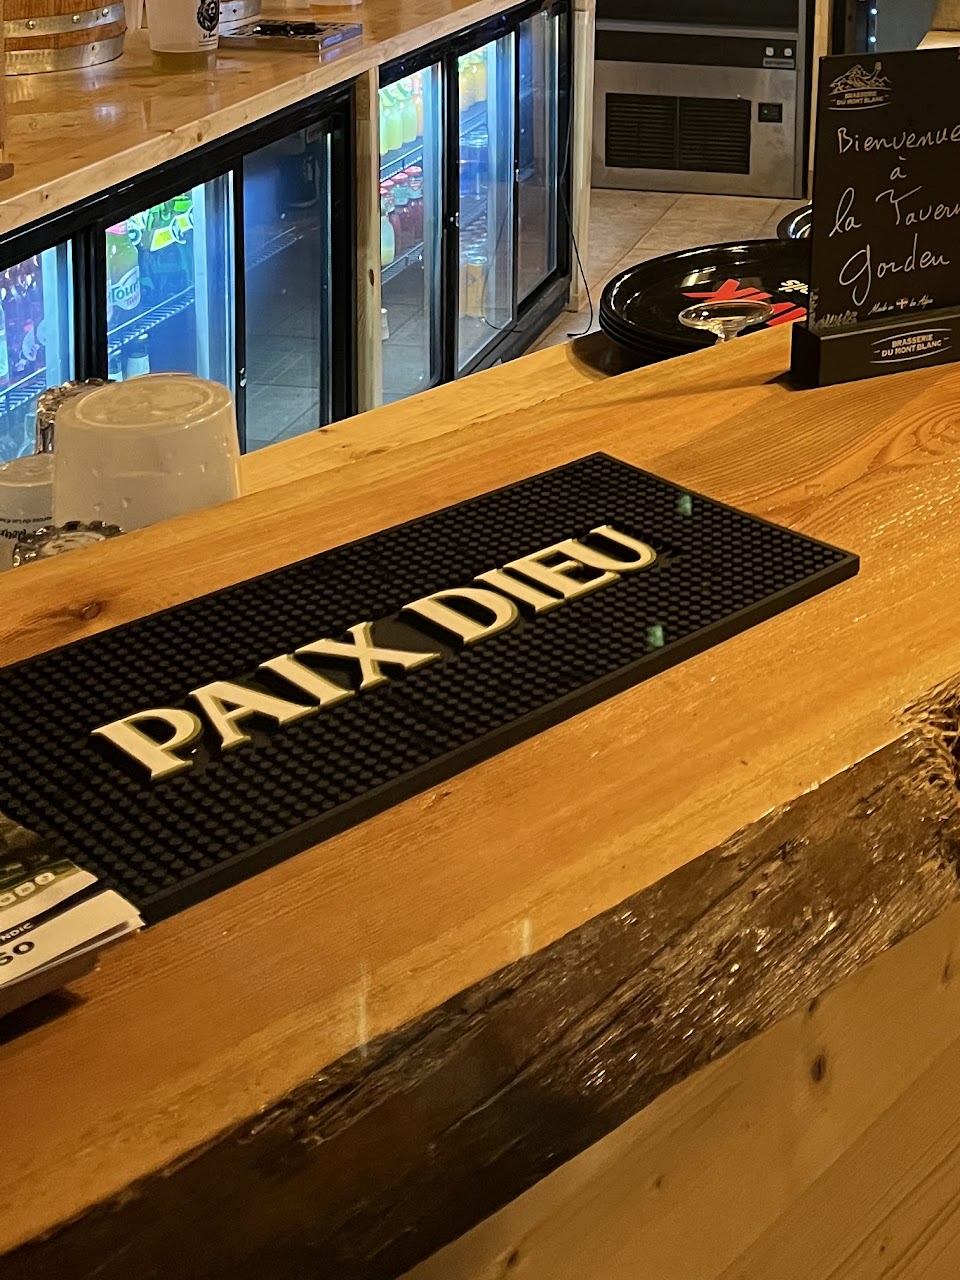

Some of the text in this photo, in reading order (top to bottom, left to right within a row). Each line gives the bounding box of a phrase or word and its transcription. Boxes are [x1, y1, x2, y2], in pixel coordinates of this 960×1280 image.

[889, 155, 907, 181] à
[829, 187, 862, 238] la
[881, 339, 942, 358] DU MONT BLANC
[891, 333, 934, 349] BRASSERIE
[91, 524, 659, 780] PAIX DIEU
